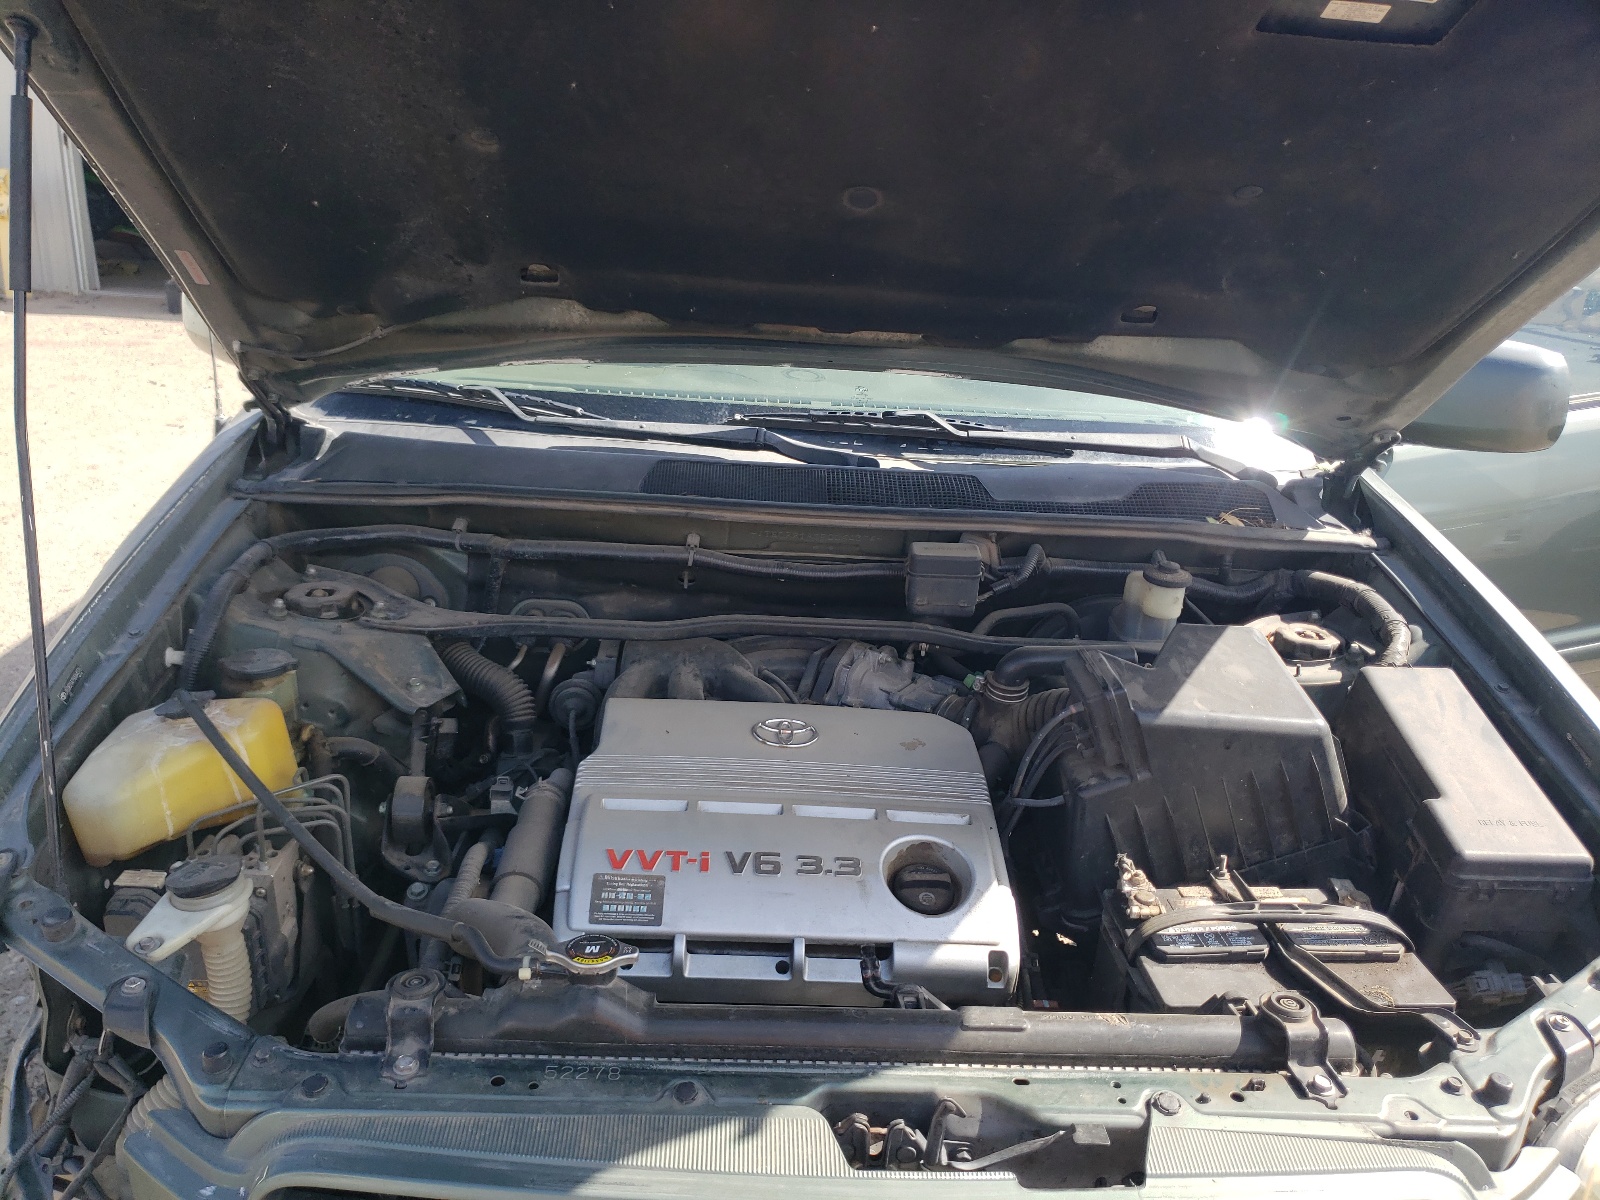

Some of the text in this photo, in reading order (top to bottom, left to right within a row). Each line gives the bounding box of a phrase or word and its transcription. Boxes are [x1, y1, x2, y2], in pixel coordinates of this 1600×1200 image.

[606, 848, 863, 878] VVT-i V6 3.3
[544, 1065, 621, 1081] 52278
